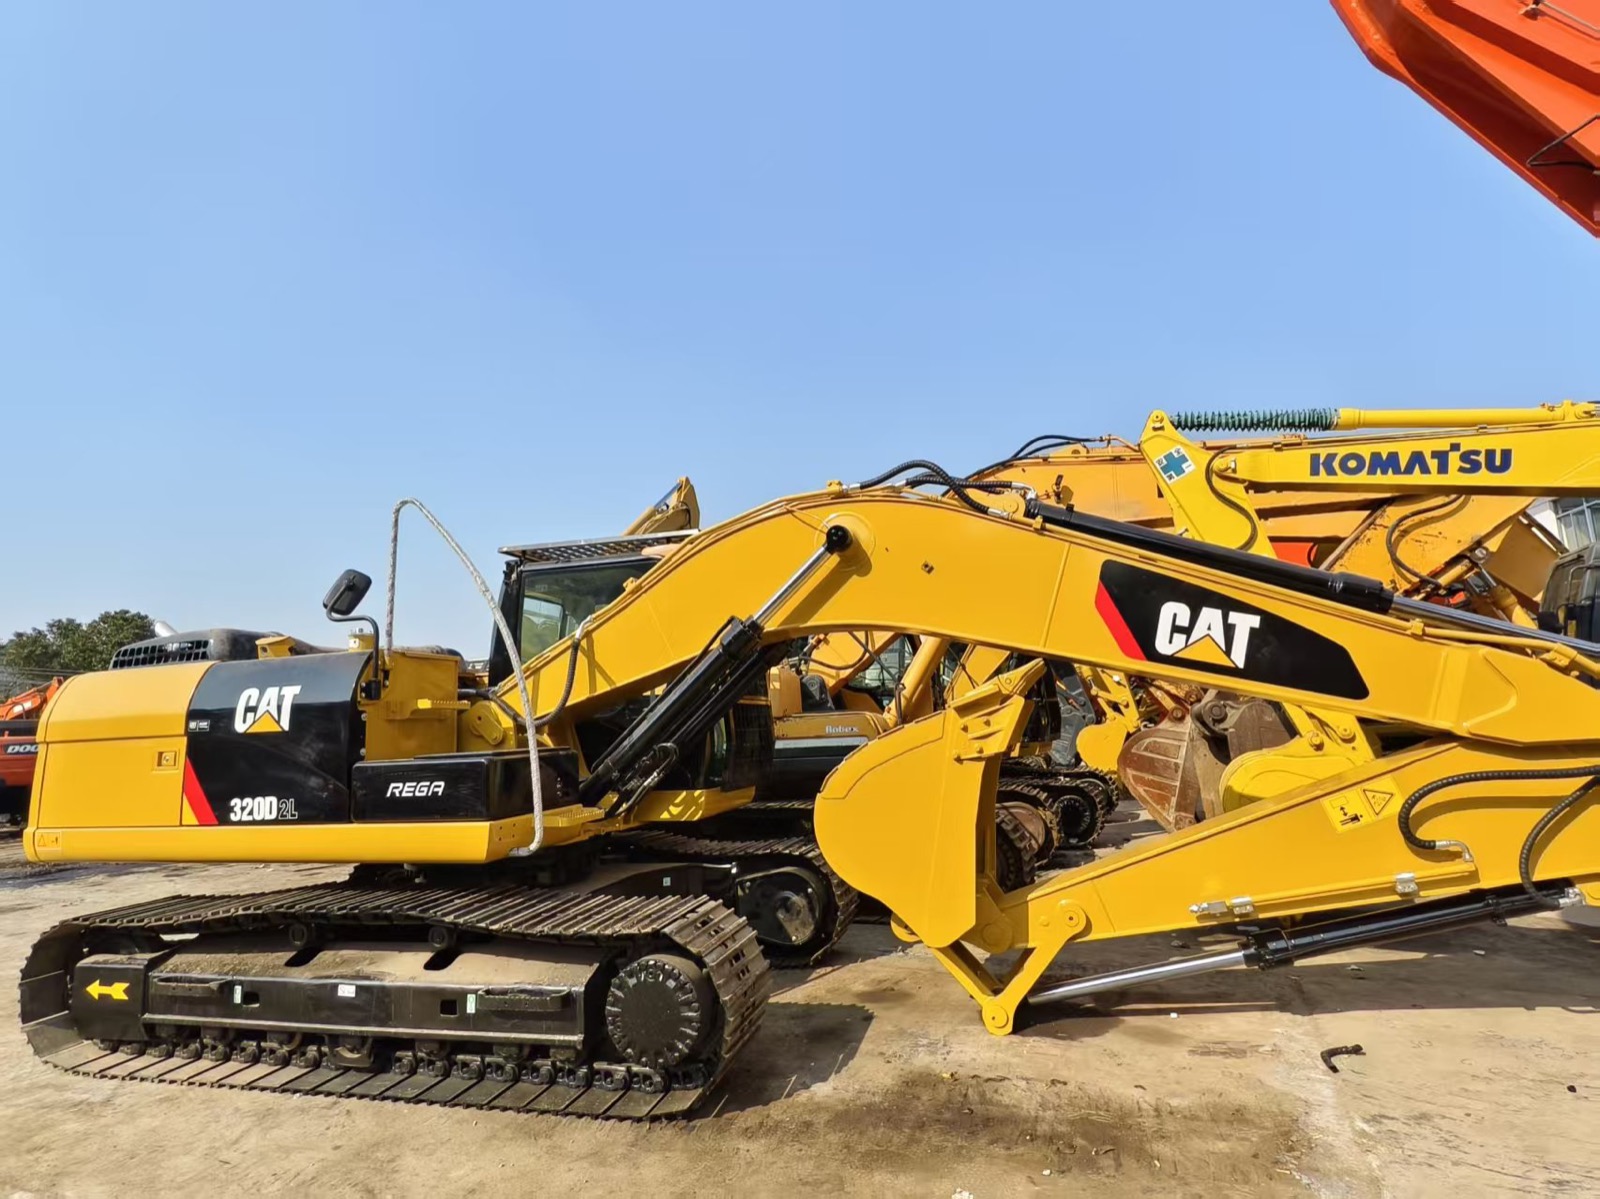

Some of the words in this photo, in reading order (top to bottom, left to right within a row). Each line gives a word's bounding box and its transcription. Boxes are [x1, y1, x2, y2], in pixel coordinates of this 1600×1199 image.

[1310, 442, 1512, 477] KOMATSU
[1154, 601, 1261, 669] CAT
[234, 685, 302, 734] CAT
[386, 781, 445, 797] REGA
